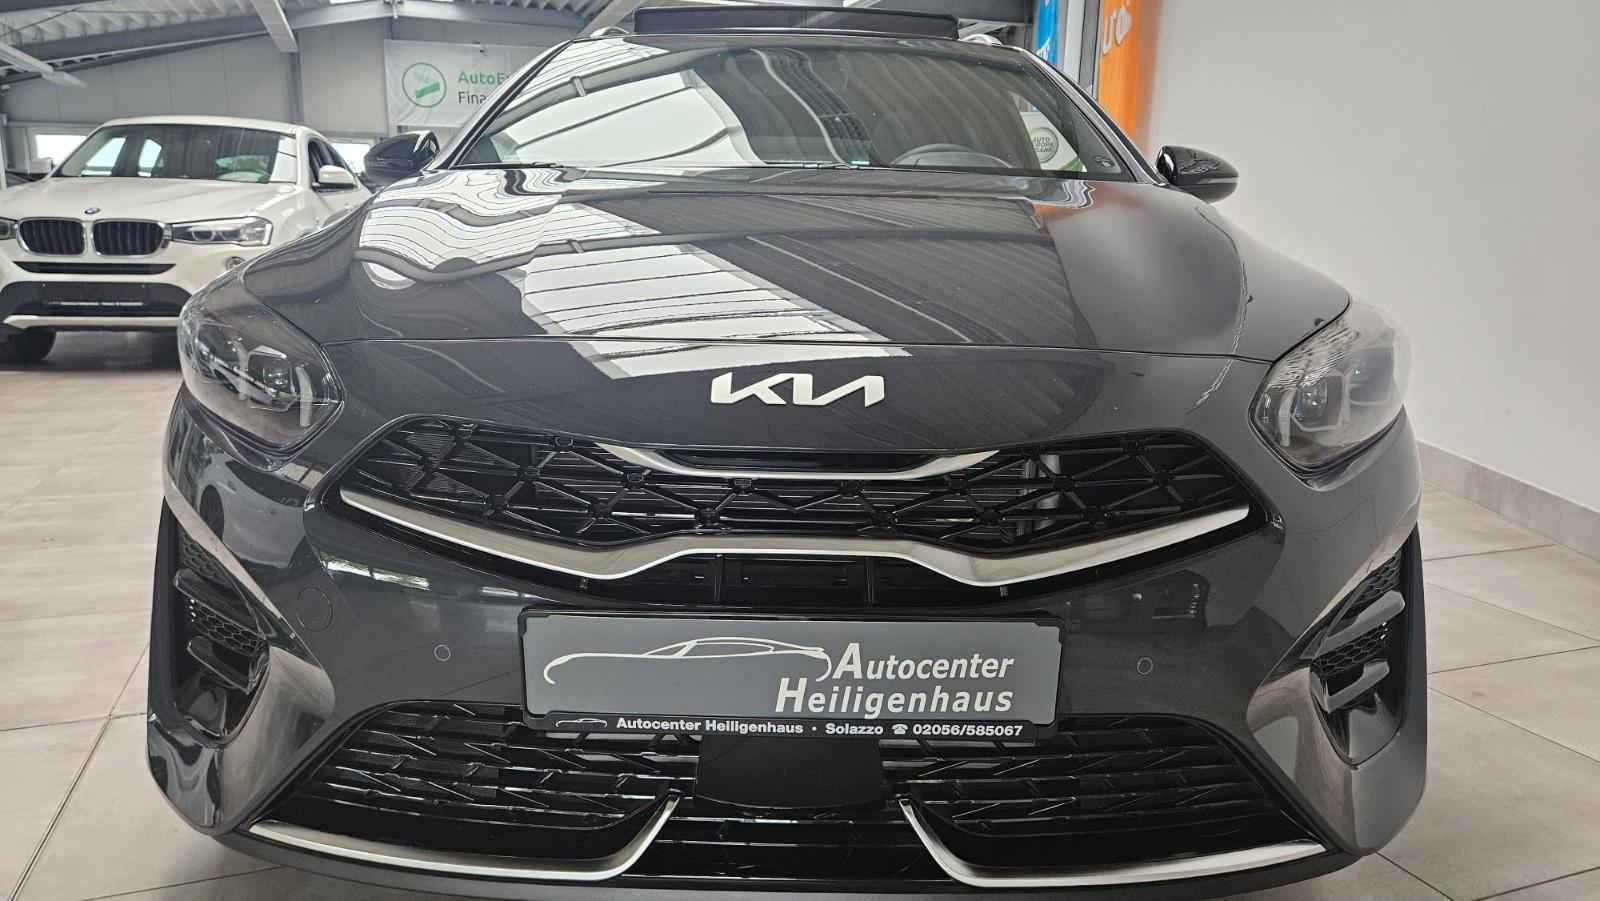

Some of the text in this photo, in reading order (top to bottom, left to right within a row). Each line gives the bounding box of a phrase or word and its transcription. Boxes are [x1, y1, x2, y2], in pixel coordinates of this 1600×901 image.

[710, 372, 885, 407] KIA
[832, 642, 1015, 680] Autocenter
[775, 677, 1014, 719] Heiligenhaus
[616, 717, 1023, 736] Autocenter Heiligenhaus Solazzo 02056/585067
